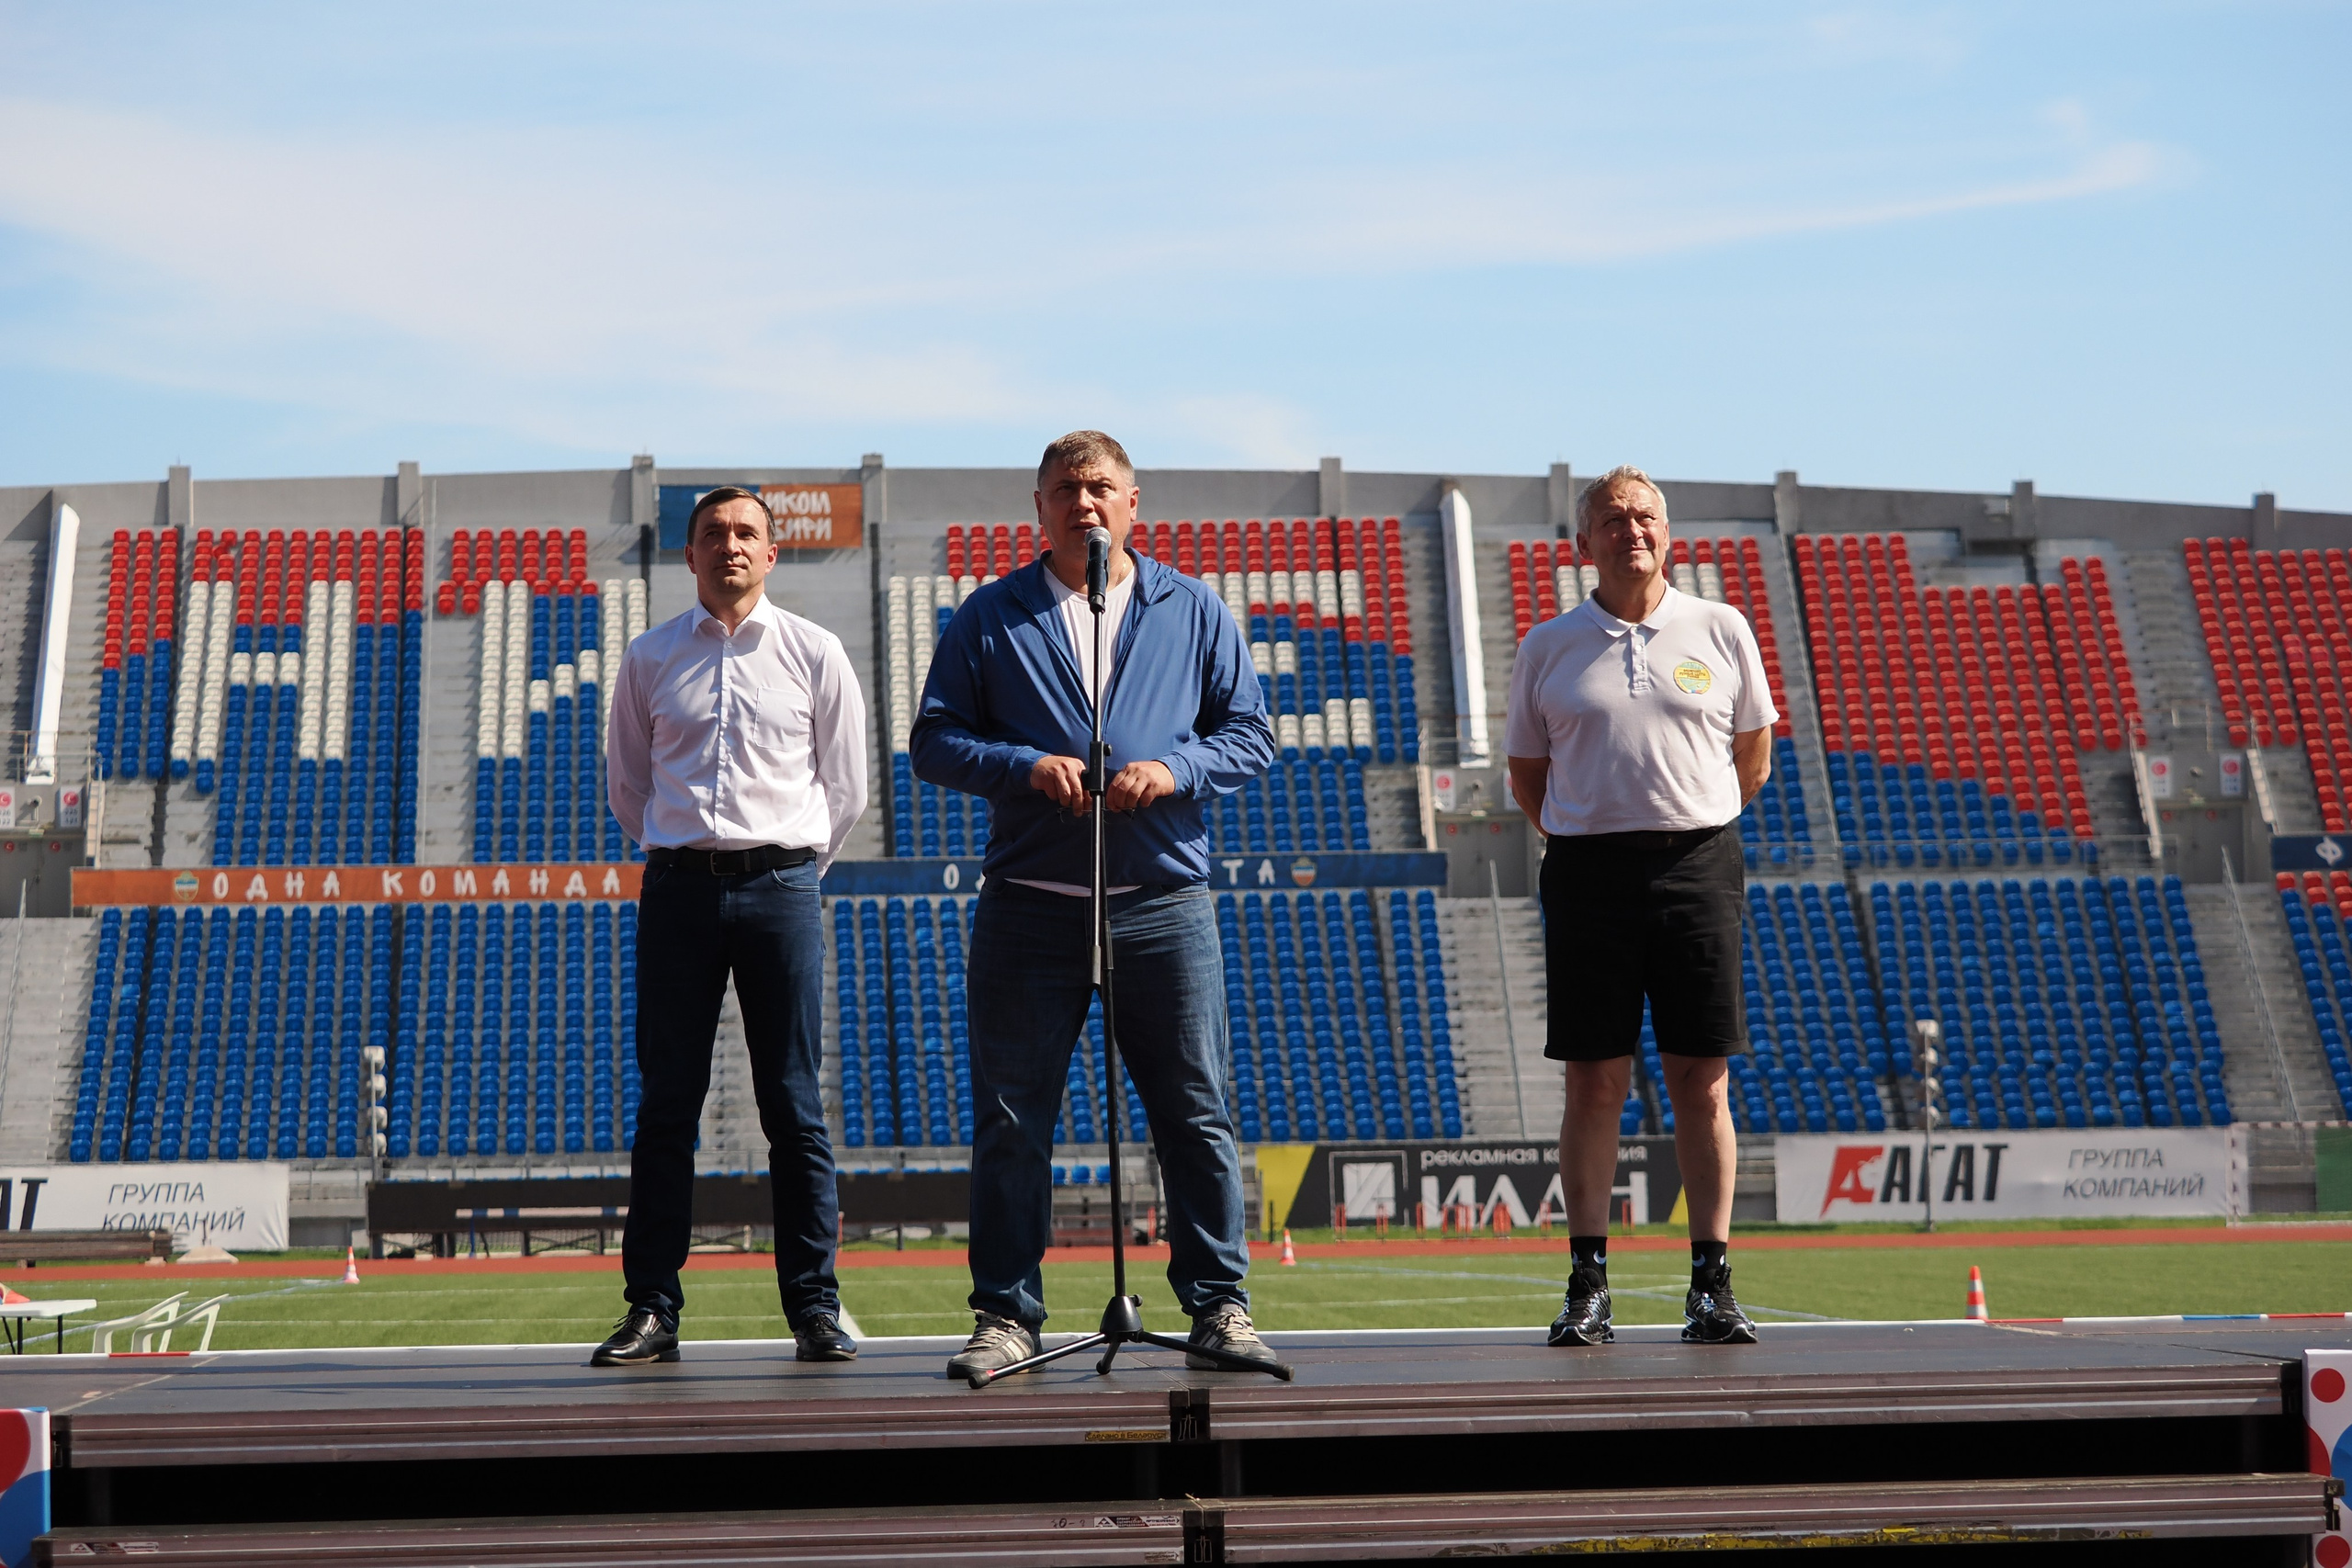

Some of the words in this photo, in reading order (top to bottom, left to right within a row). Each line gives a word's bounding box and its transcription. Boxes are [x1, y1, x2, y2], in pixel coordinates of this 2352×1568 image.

[212, 871, 341, 902] ОДНА
[381, 868, 621, 897] КОМАНДА
[1420, 1148, 1539, 1171] рекламная
[2067, 1148, 2164, 1168] ГРУППА
[1881, 1143, 2008, 1202] АГАТ
[2063, 1172, 2203, 1199] КОМПАНИЙ
[107, 1181, 204, 1204] ГРУППА
[101, 1206, 245, 1232] КОМПАНИЙ
